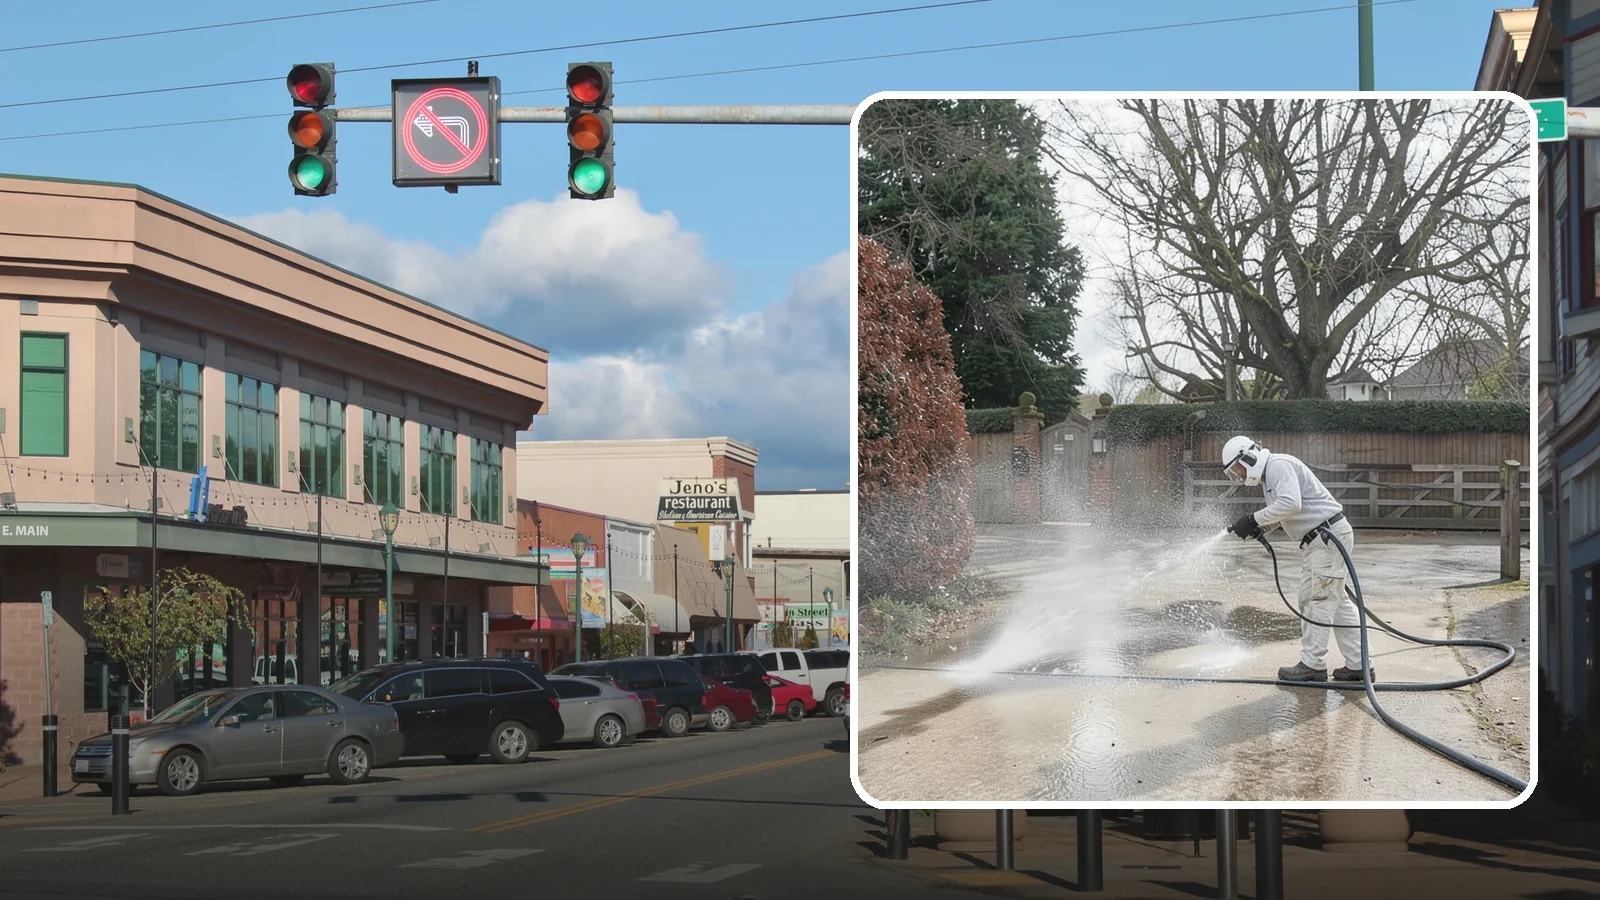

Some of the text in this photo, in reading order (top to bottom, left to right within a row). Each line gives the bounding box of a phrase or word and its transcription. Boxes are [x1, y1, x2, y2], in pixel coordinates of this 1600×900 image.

[669, 480, 727, 494] Jeno's
[665, 496, 731, 509] restaurant
[658, 510, 682, 519] Italian
[686, 510, 714, 519] American
[715, 509, 737, 519] Cuisine
[2, 525, 49, 536] E. MAIN
[797, 608, 828, 616] Street
